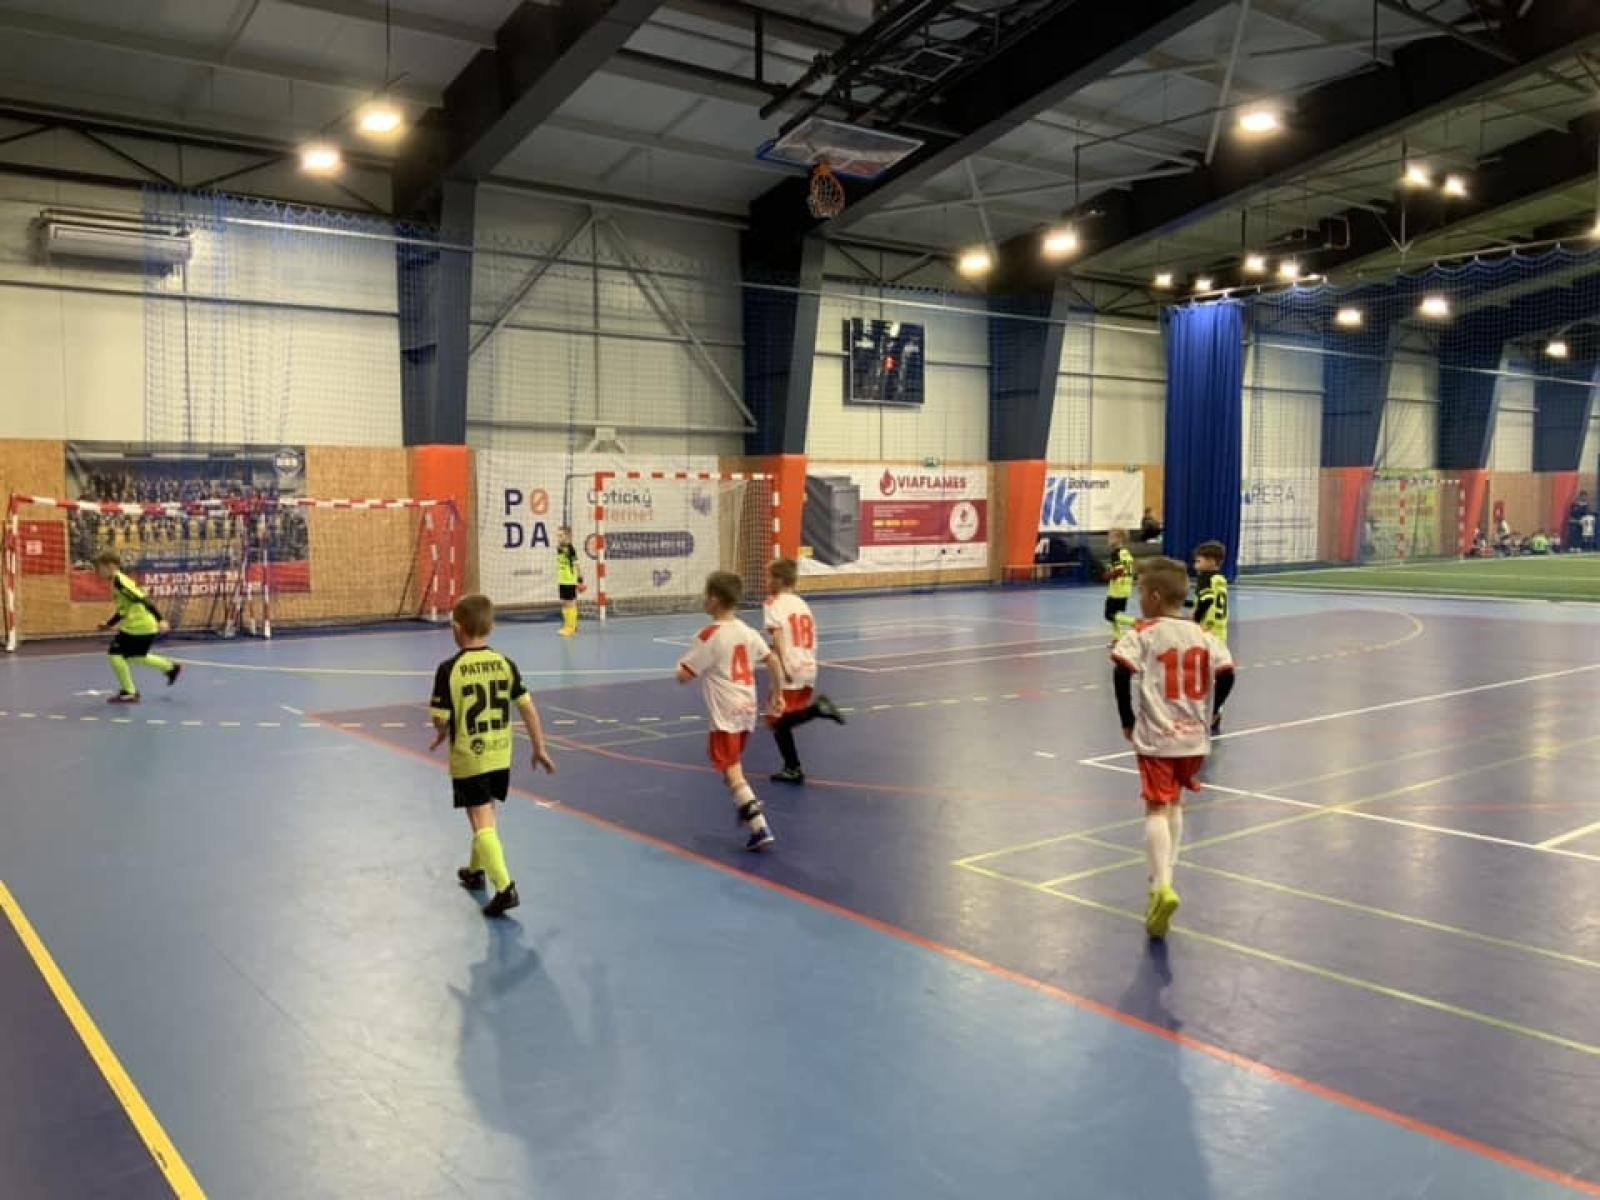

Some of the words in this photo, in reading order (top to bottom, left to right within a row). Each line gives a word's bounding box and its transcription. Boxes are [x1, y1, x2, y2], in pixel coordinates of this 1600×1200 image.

[897, 474, 966, 489] VIAFLAMES
[503, 521, 550, 548] DA
[787, 613, 815, 650] 18
[730, 643, 754, 685] 4
[1157, 646, 1211, 700] 10
[461, 680, 510, 736] 25
